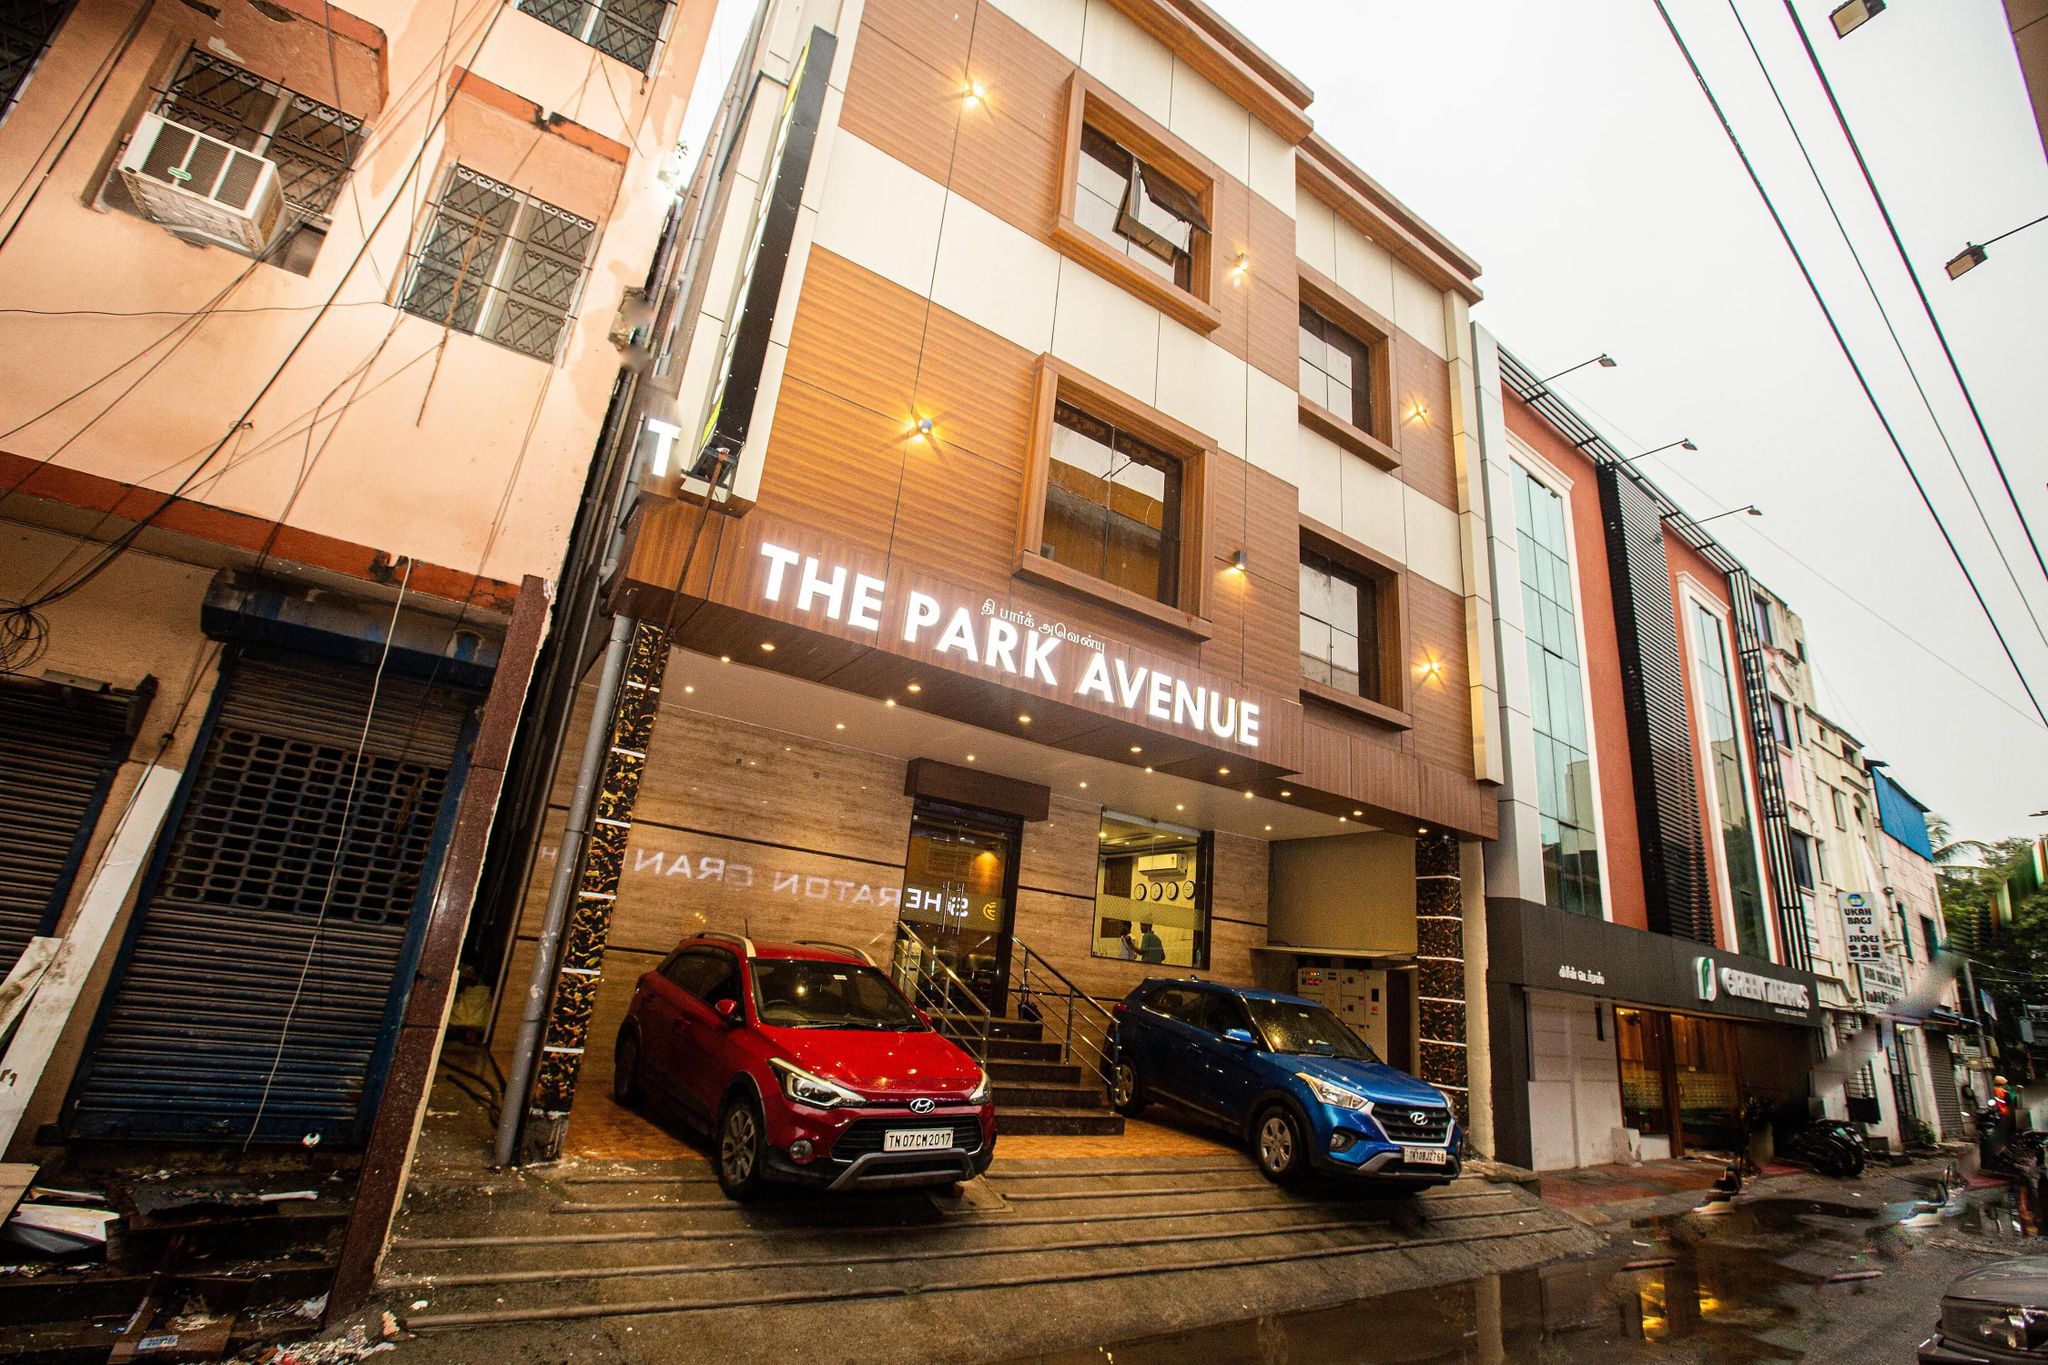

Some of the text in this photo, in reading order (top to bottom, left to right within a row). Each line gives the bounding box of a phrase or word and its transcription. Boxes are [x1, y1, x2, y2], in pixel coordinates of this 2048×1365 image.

[648, 418, 681, 477] T
[981, 598, 996, 616] தி
[761, 543, 1259, 747] THE PARK AVENUE
[1847, 917, 1872, 925] BAGS
[1849, 935, 1880, 943] SHOES
